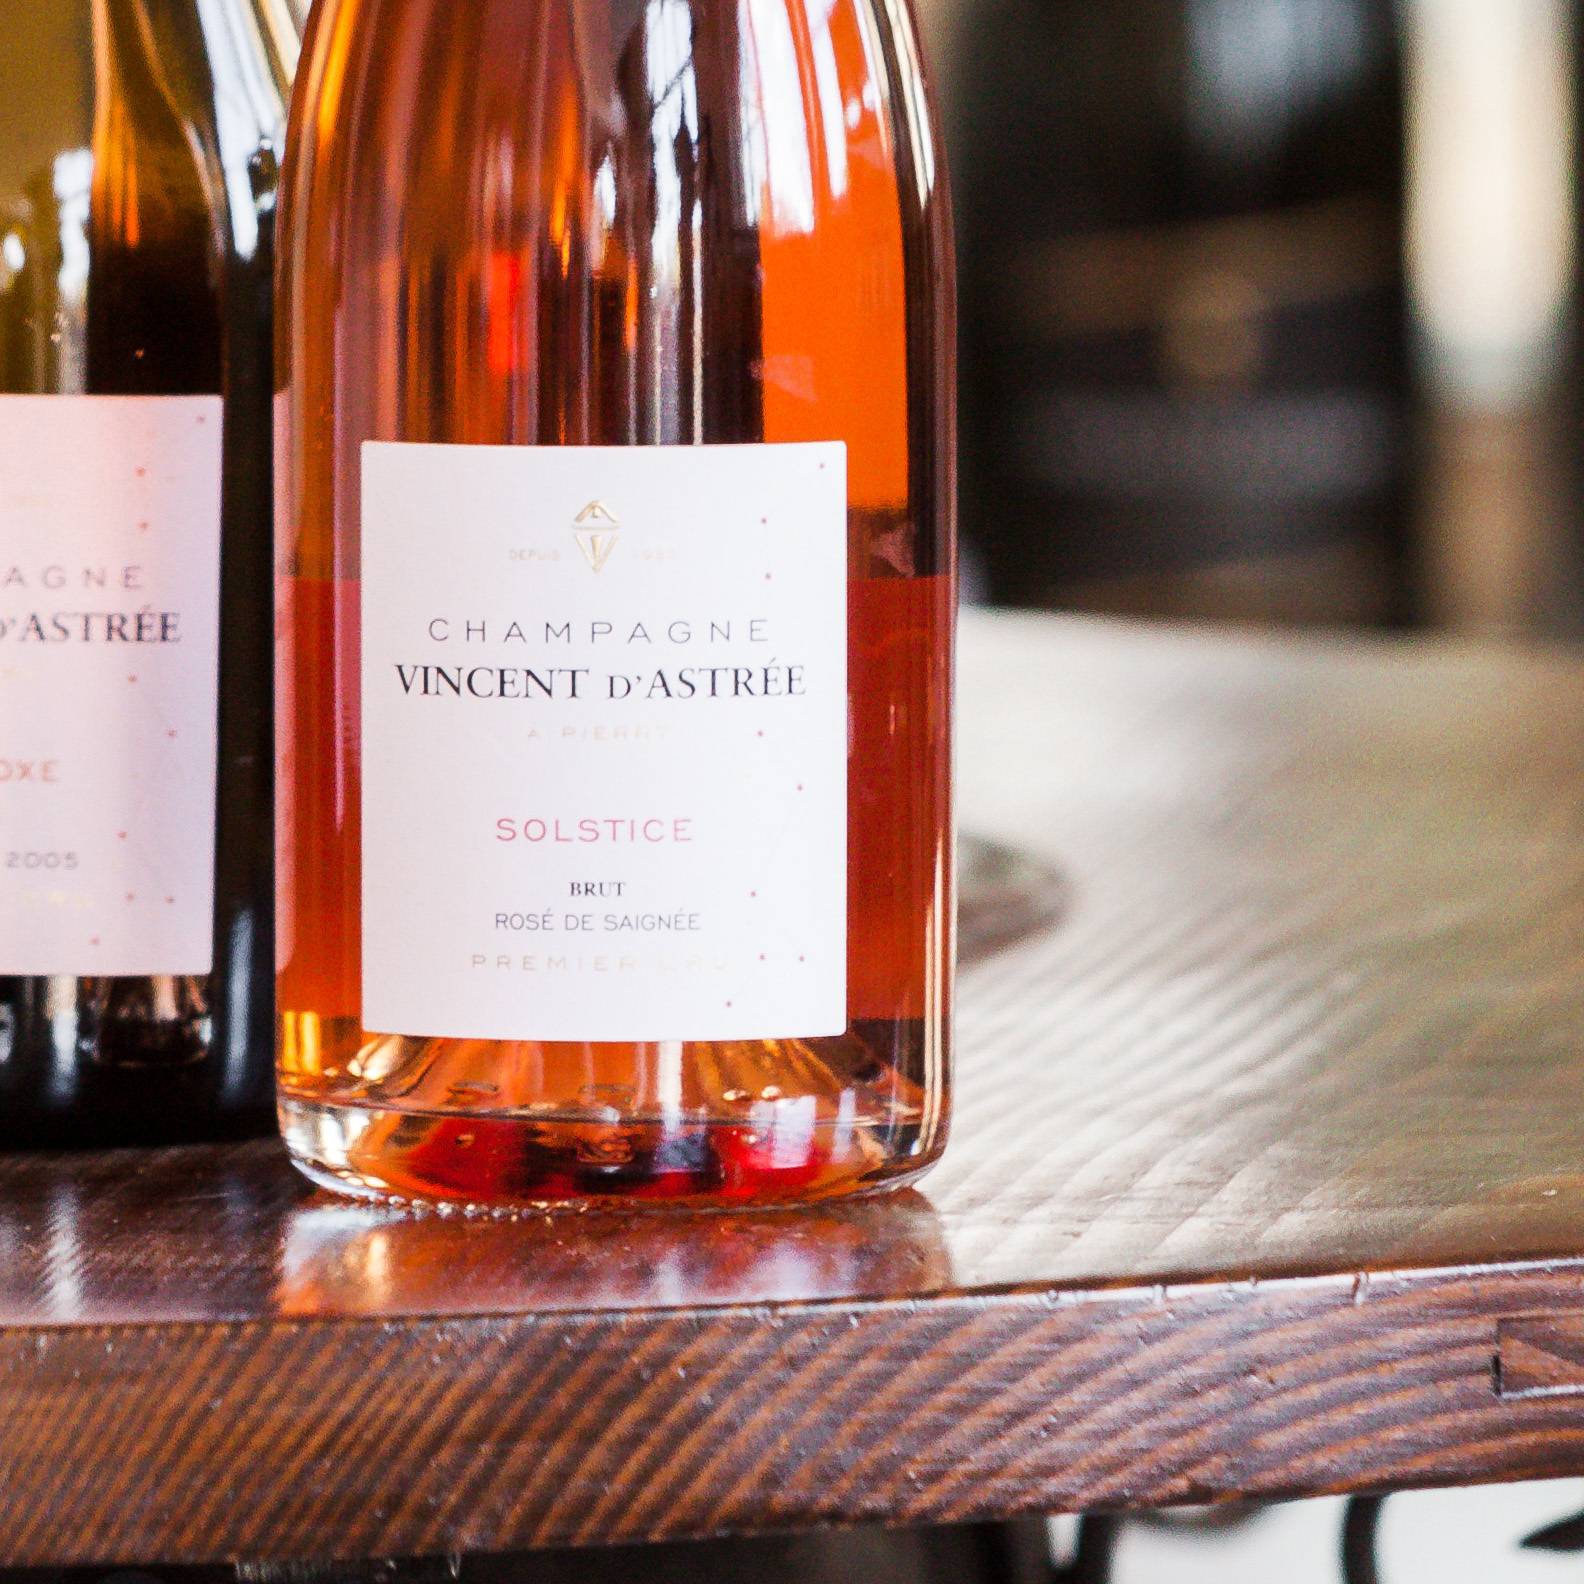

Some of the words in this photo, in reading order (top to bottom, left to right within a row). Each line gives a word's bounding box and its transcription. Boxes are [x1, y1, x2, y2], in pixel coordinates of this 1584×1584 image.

[428, 618, 770, 645] CHAMPAGNE
[394, 663, 590, 699] VINCENT
[607, 658, 807, 700] D'ASTRÉE
[496, 817, 693, 842] SOLSTICE
[6, 851, 79, 869] 2005
[569, 881, 626, 898] BRUT
[495, 908, 554, 932] ROSÉ
[565, 913, 594, 931] DE
[604, 907, 701, 932] SAIGNÉE
[471, 954, 638, 972] PREMIER
